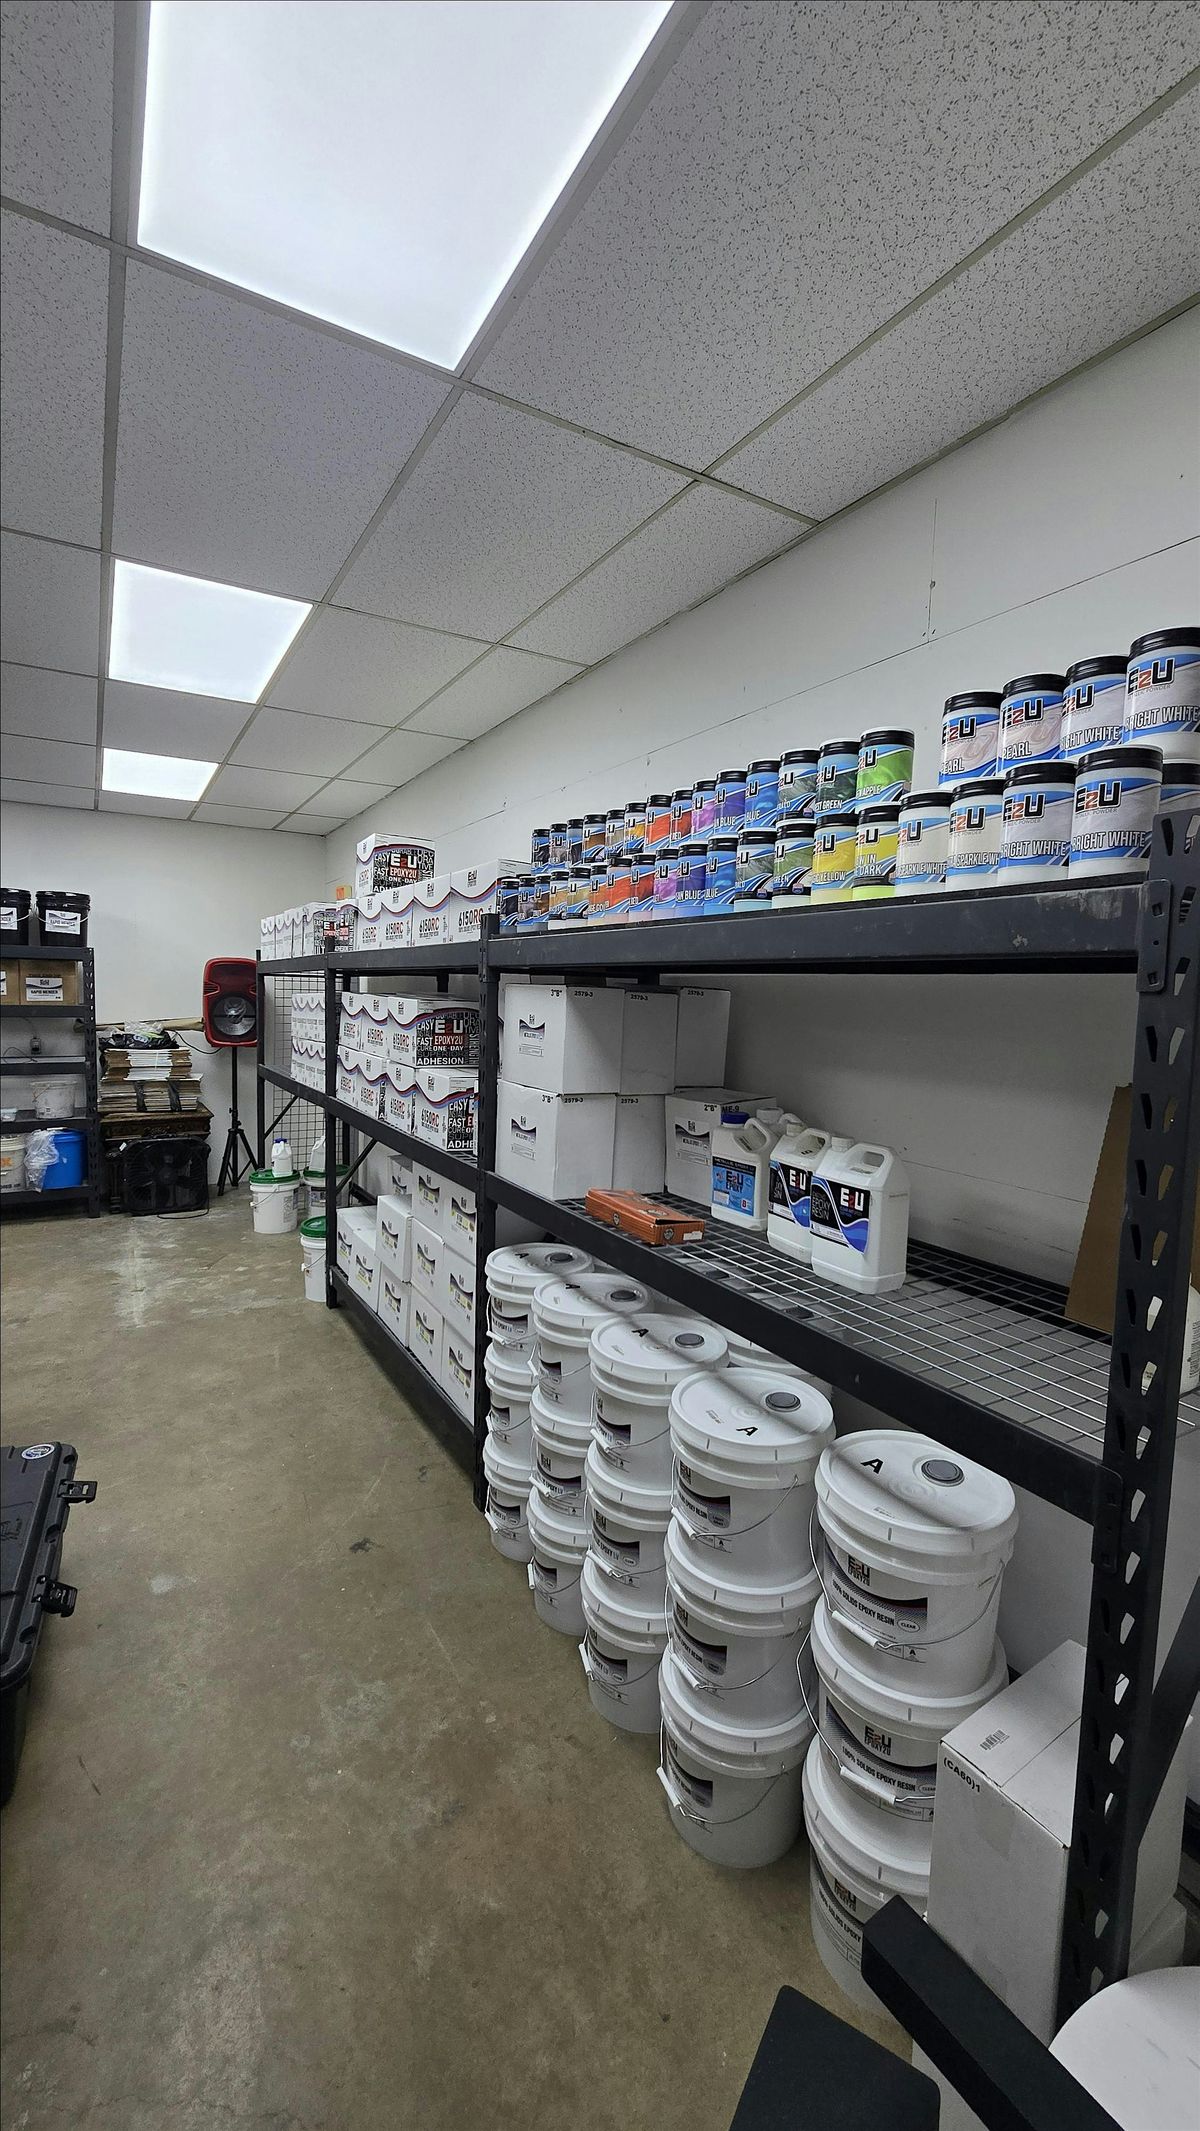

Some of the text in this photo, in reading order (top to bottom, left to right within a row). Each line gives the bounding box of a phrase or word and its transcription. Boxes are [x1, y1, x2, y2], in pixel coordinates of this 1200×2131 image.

[1127, 657, 1175, 696] E2U
[1002, 698, 1043, 729] E2U
[1161, 705, 1200, 723] WHITE
[1084, 725, 1121, 744] WHITE
[1075, 780, 1121, 814] E2U
[1002, 793, 1045, 822] E2U
[1032, 840, 1068, 857] WHITE
[1072, 830, 1147, 852] BRIGHT WHITE
[391, 853, 417, 868] E2U
[374, 867, 389, 877] FAST
[390, 867, 417, 878] EPOXY2U
[419, 916, 440, 932] 6150RC
[417, 1037, 433, 1047] FAST
[434, 1035, 463, 1045] EPOXY2U
[416, 1057, 464, 1065] ADHESION
[448, 1117, 466, 1127] FAST
[447, 1140, 474, 1149] ADHE
[726, 1170, 744, 1186] E2U
[841, 1187, 864, 1211] E2U
[515, 1251, 529, 1259] A
[565, 1282, 581, 1291] A
[631, 1327, 649, 1338] A
[735, 1426, 758, 1437] A
[860, 1458, 884, 1475] A
[858, 1603, 877, 1619] EPOXY
[877, 1612, 895, 1626] RESIN
[901, 1622, 916, 1630] CLEAR
[865, 1725, 892, 1748] E2U
[856, 1758, 876, 1777] SOLIDS
[876, 1771, 897, 1787] EPOXY
[897, 1780, 917, 1792] RESIN
